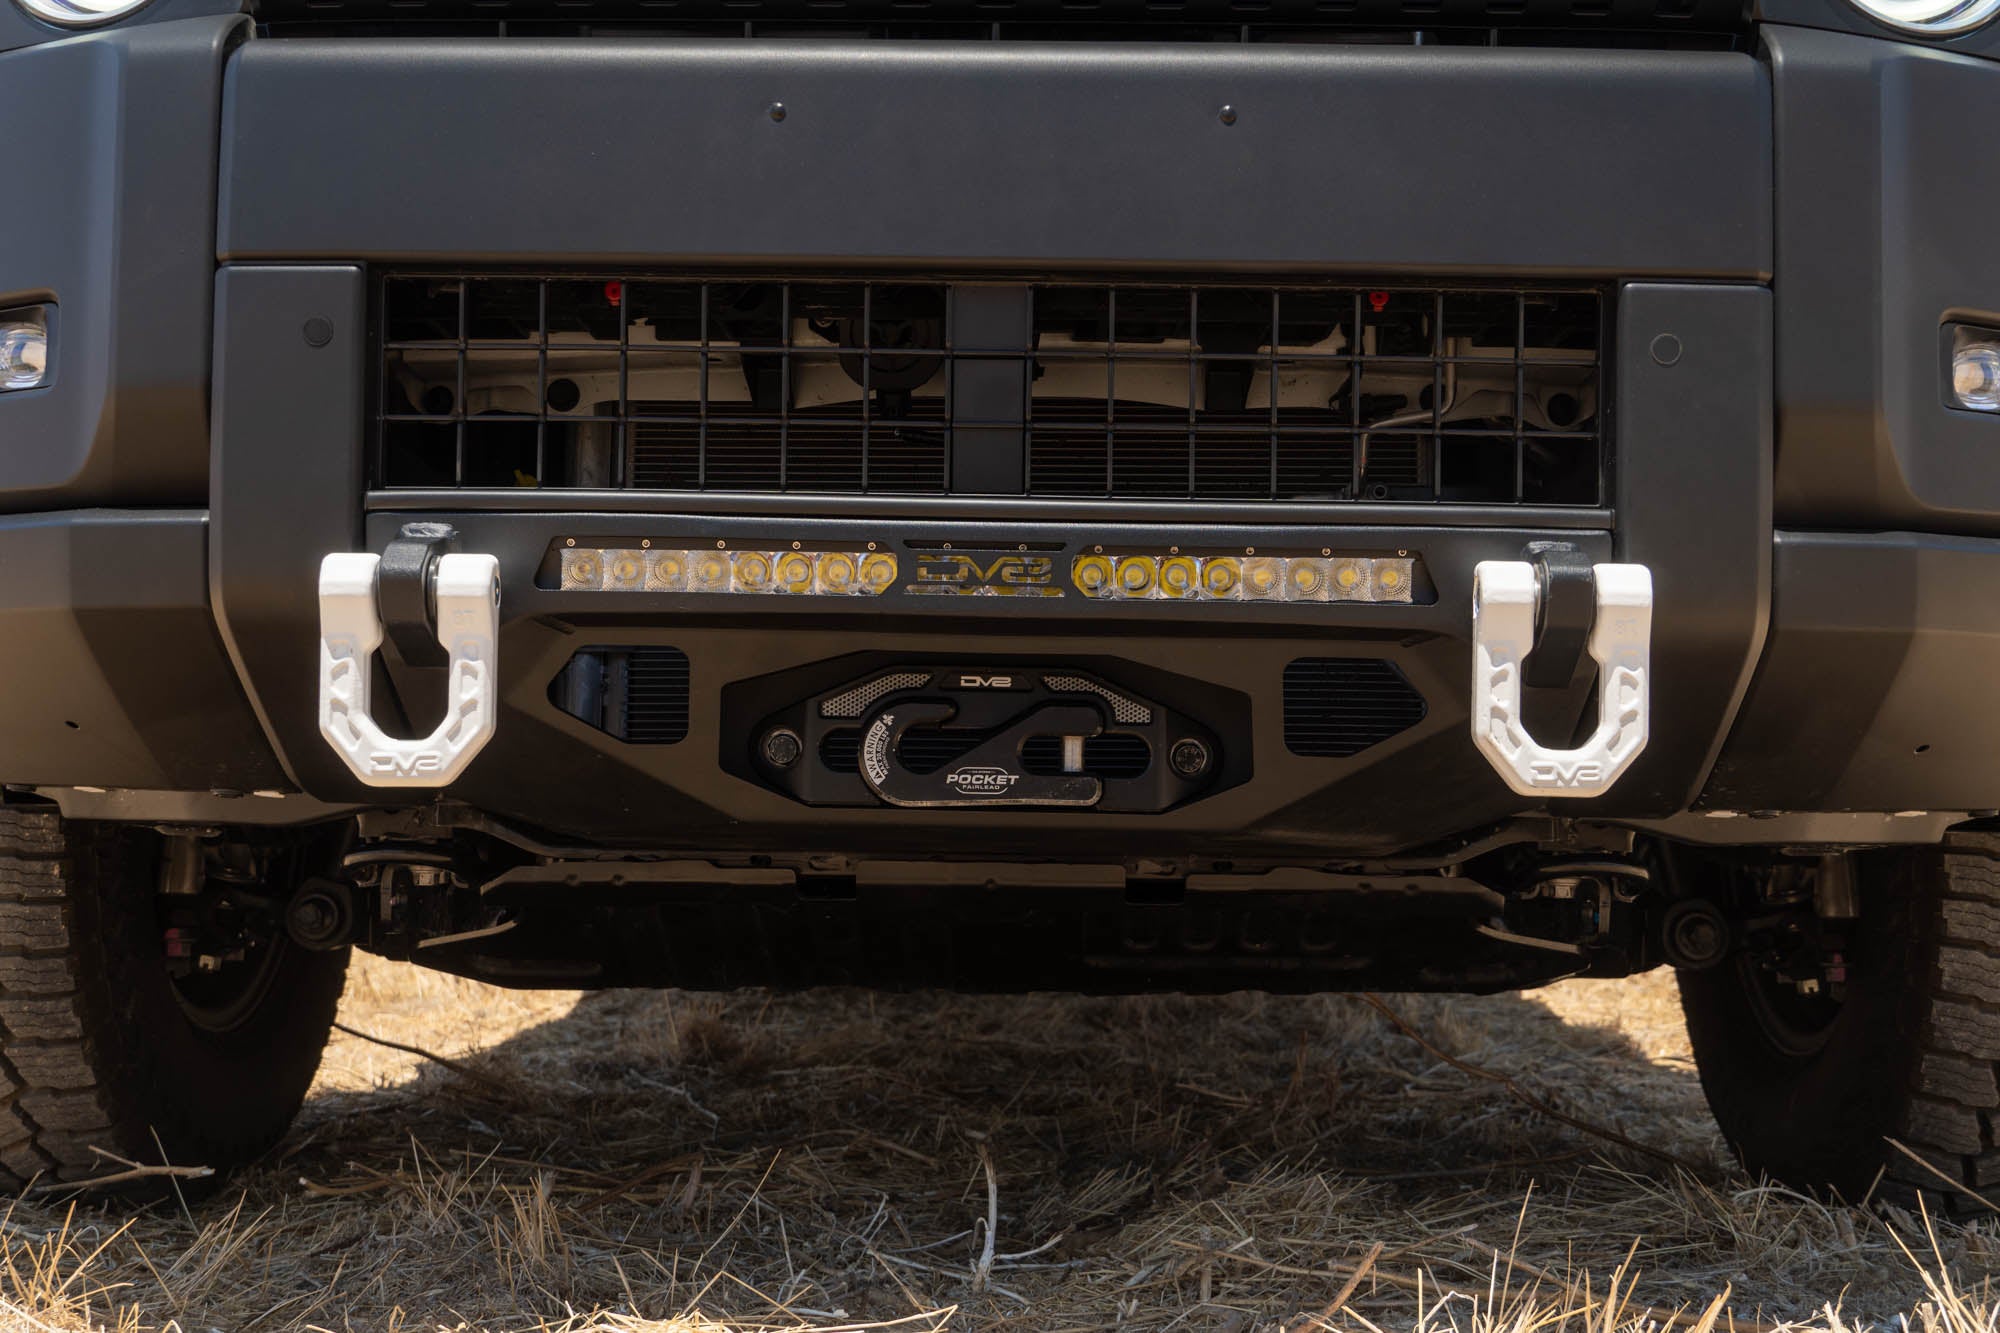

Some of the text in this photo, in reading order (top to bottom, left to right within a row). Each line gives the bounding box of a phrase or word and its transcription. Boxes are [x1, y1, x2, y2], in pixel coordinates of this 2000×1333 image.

[866, 724, 883, 773] WARNING
[878, 761, 889, 775] MAX
[946, 774, 1019, 785] POCKET
